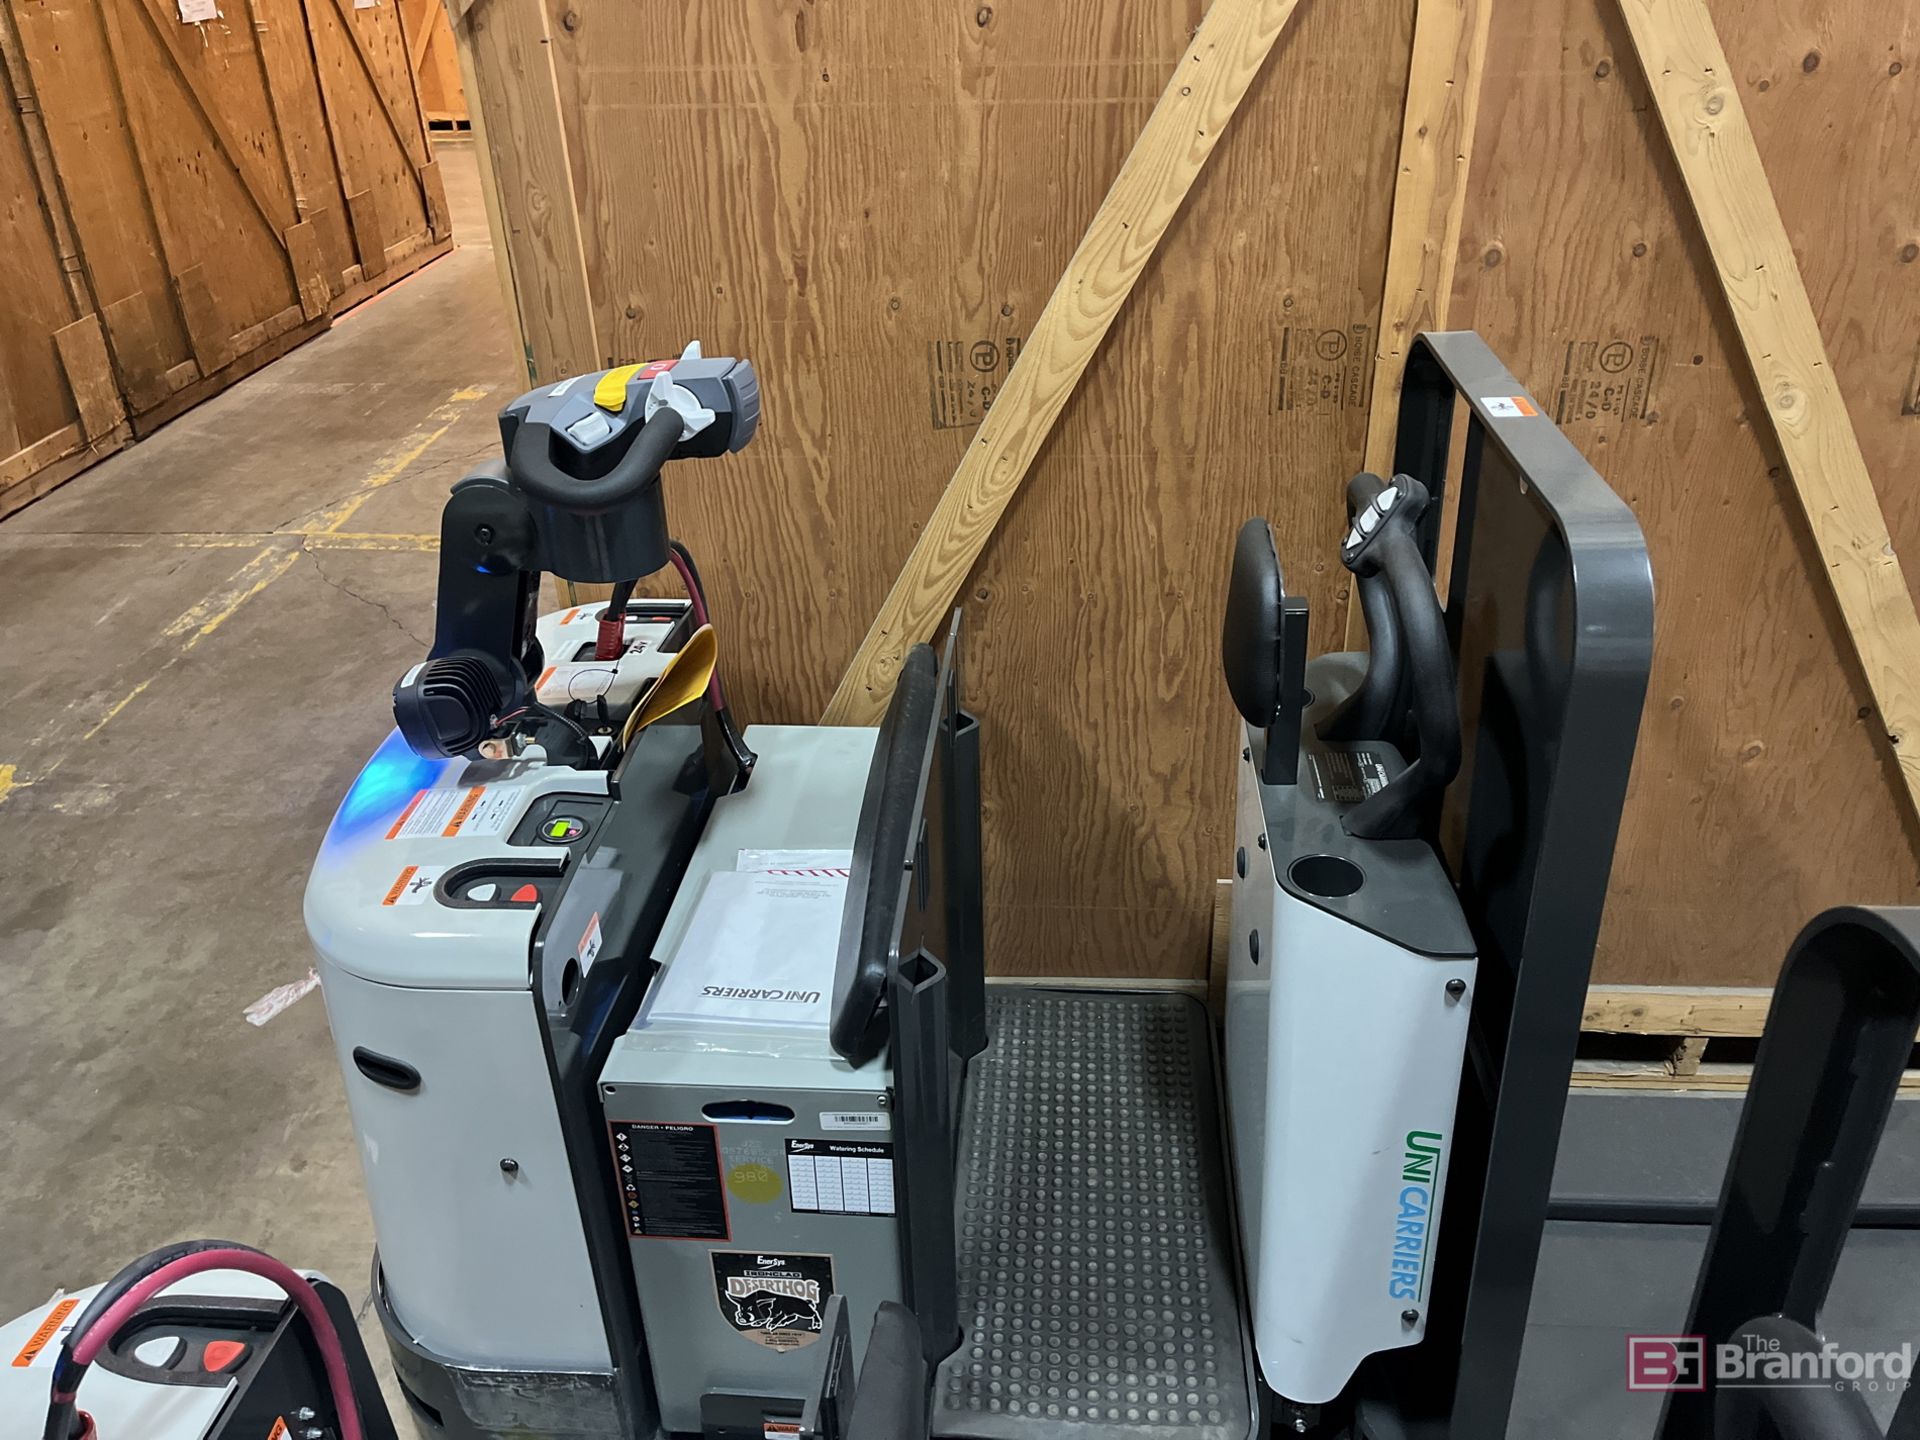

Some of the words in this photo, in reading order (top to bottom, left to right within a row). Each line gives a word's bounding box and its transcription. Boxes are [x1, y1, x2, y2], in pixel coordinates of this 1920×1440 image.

[1601, 387, 1615, 412] C-D
[829, 1145, 856, 1153] Watering
[757, 1256, 786, 1267] EnerSys
[30, 1301, 75, 1347] WARNING
